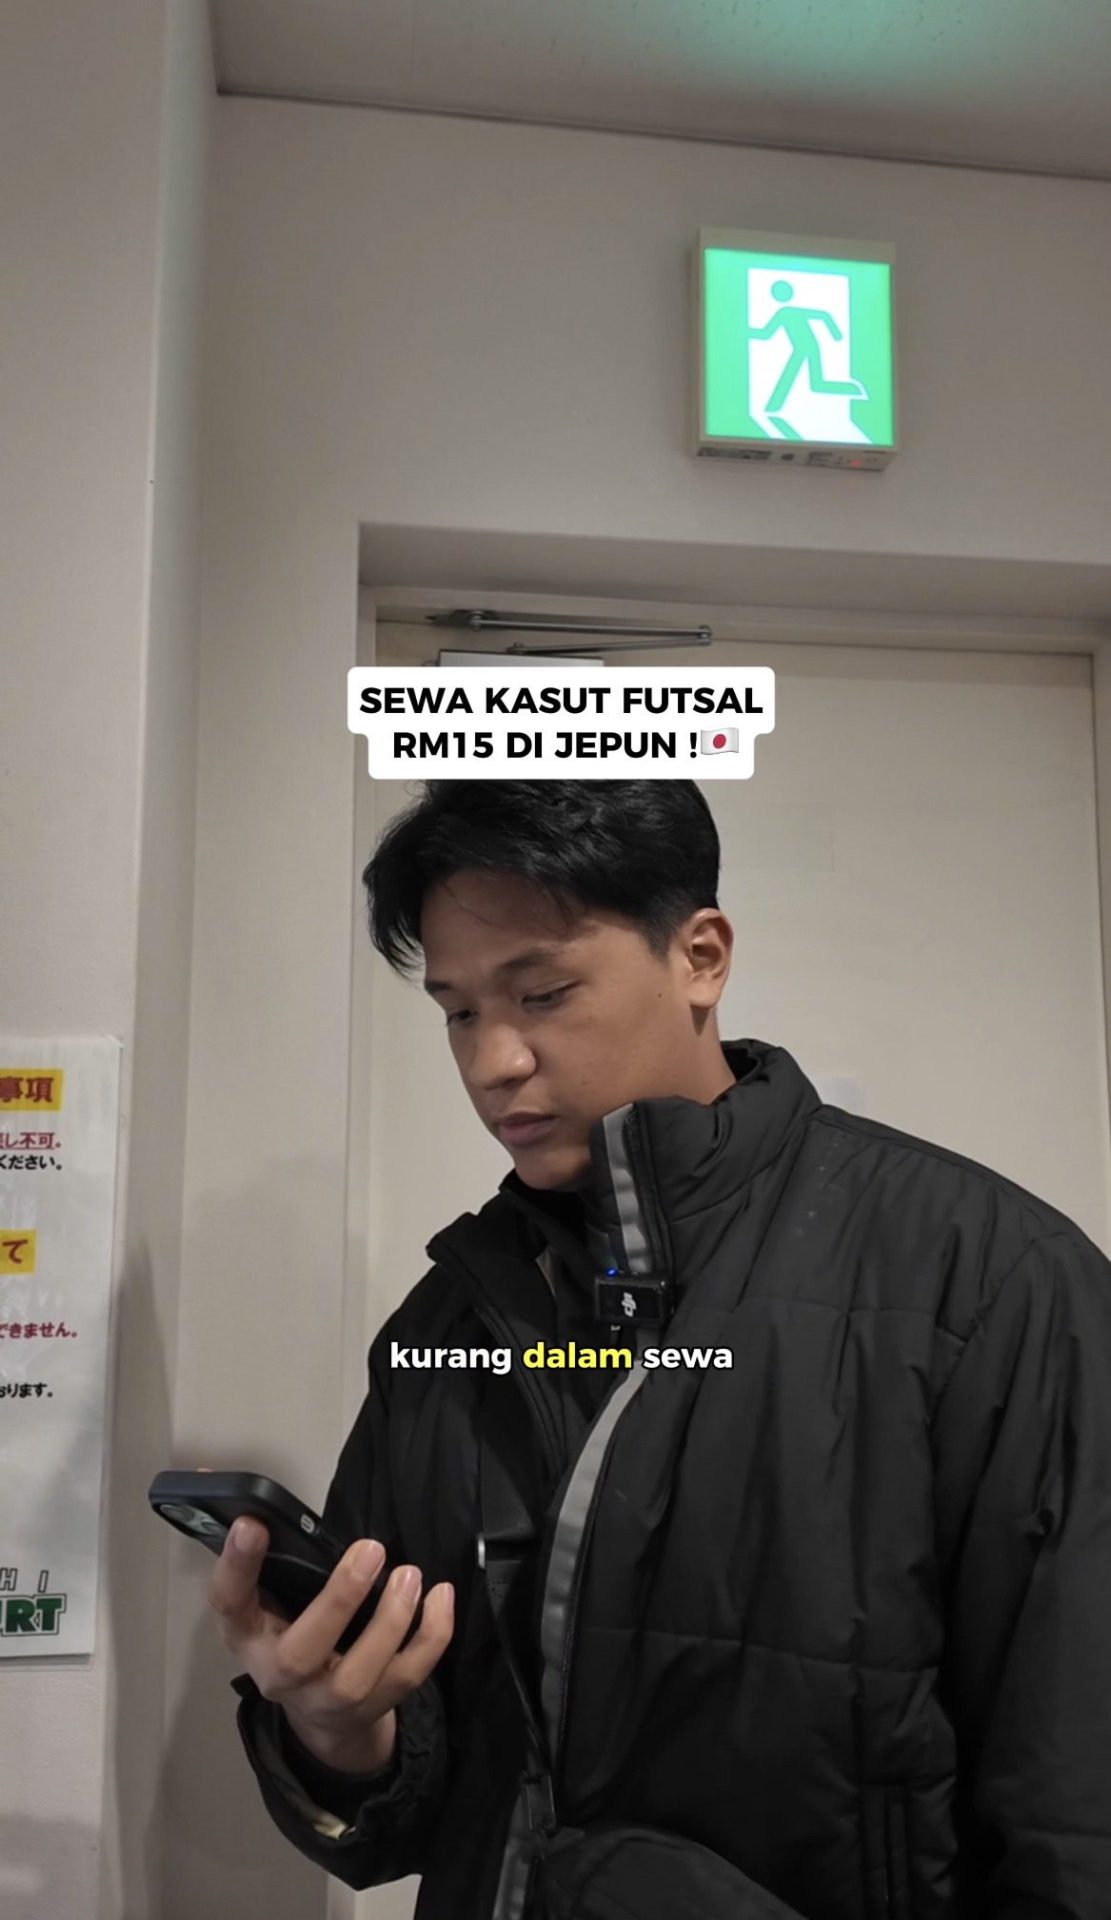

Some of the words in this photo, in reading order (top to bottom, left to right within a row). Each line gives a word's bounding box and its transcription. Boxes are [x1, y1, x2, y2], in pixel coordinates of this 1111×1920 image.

[0, 1132, 61, 1149] し不可。
[2, 1239, 29, 1264] て
[0, 1594, 67, 1637] RT
